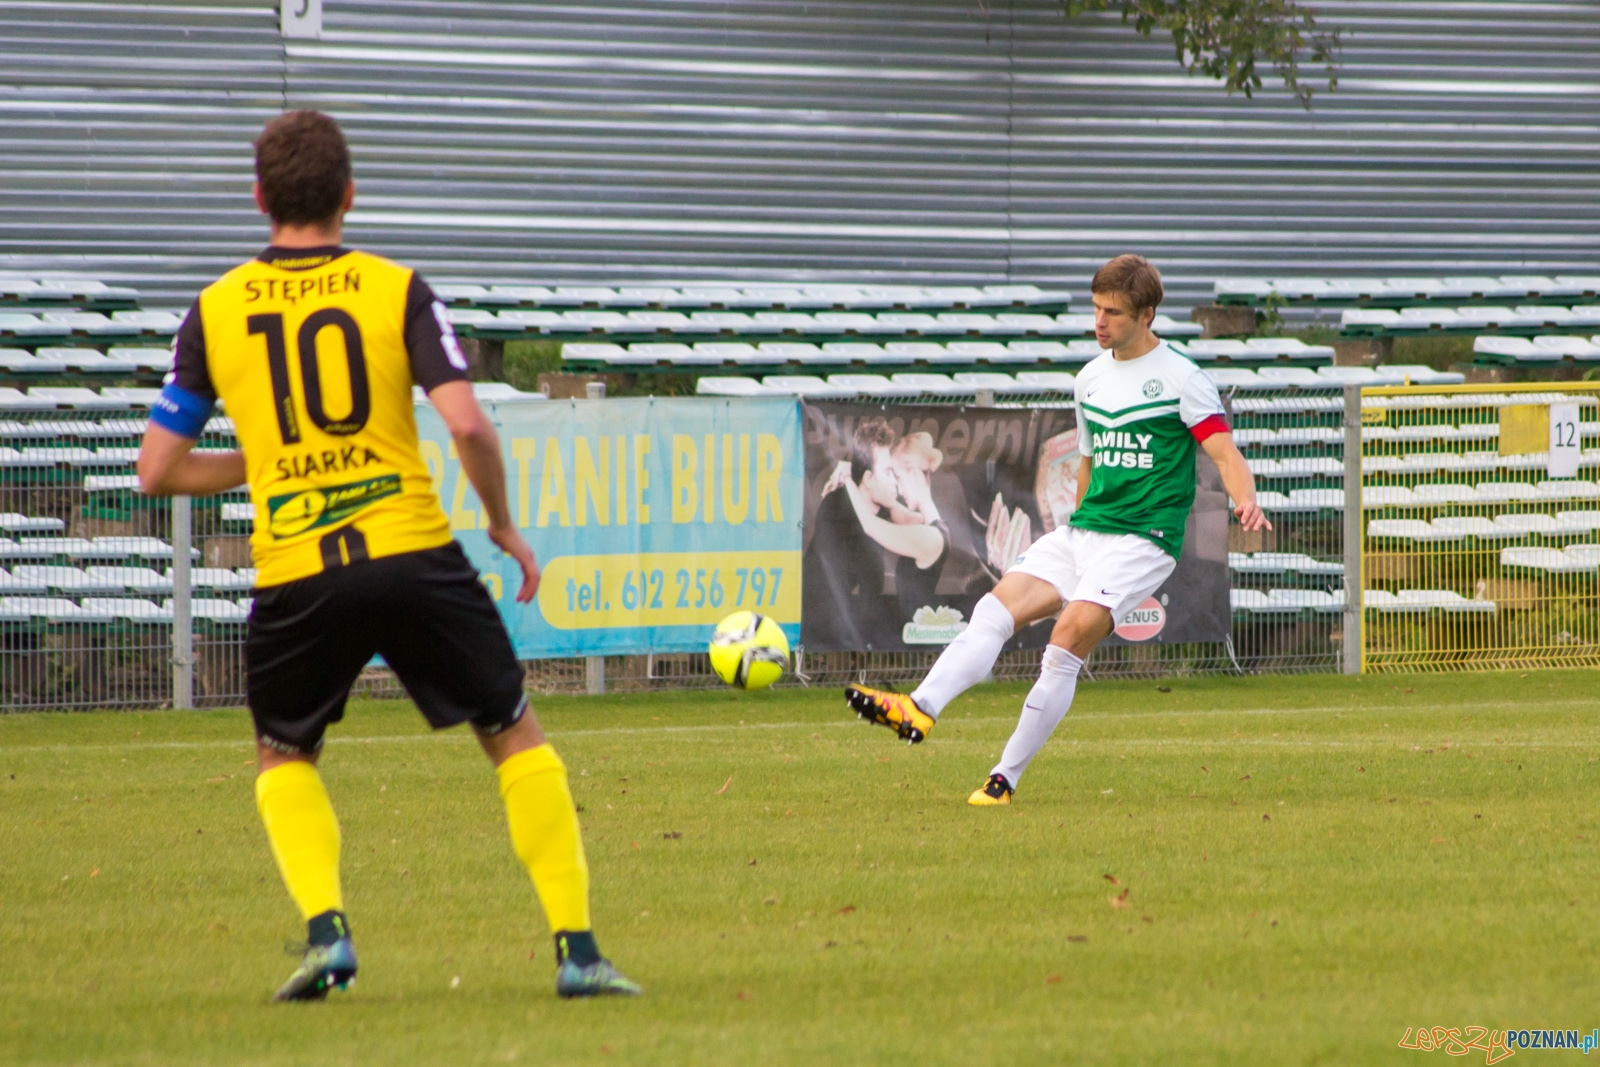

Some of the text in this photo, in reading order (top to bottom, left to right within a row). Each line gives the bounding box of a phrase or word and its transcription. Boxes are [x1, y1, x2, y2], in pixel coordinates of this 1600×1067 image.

[245, 267, 361, 305] STĘPIEŃ
[246, 307, 371, 445] 10
[1093, 431, 1153, 450] AMILY
[1555, 421, 1576, 447] 12
[276, 446, 382, 480] SIARKA
[1094, 450, 1153, 469] OUSE
[418, 433, 784, 530] RZTANIE BIUR
[565, 567, 783, 612] tel. 602 256 797
[906, 625, 960, 639] Mestemach
[1125, 610, 1159, 624] ENUS
